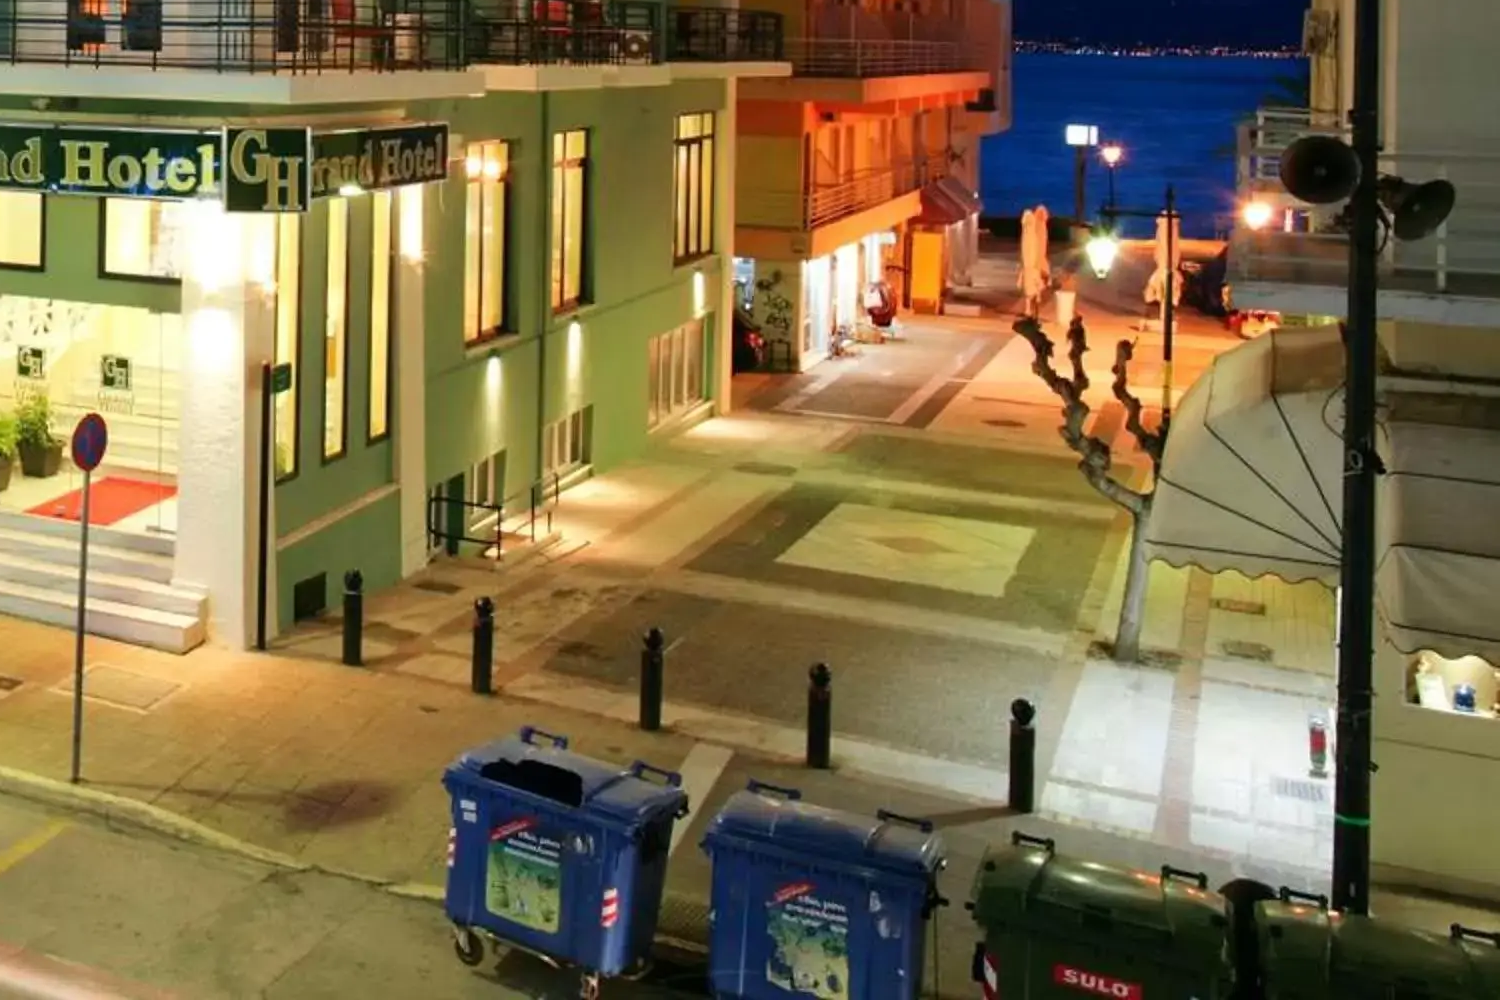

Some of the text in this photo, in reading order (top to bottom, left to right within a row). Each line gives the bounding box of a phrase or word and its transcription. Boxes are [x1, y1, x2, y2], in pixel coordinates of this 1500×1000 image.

[60, 138, 216, 193] Hotel
[311, 133, 445, 193] rand Hotel
[1063, 969, 1129, 998] SULO
